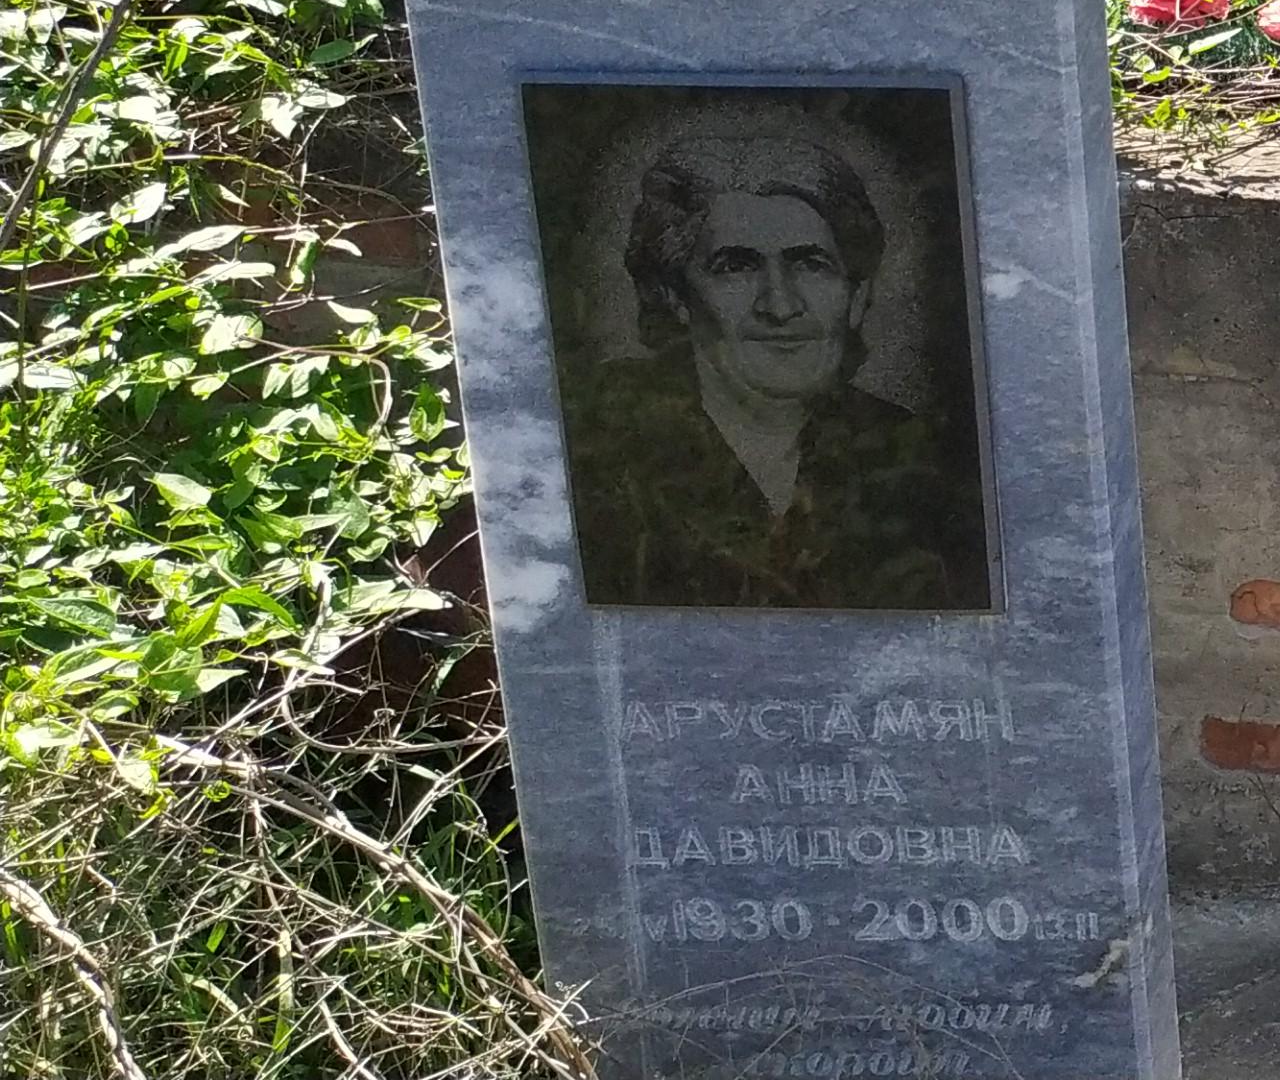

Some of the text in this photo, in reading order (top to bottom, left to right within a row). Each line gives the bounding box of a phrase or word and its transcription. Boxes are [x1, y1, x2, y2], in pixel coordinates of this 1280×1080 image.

[622, 697, 1016, 743] АРУСТАМЯН
[728, 763, 910, 806] АННА
[631, 824, 1031, 870] ДАВИДОВНА
[853, 895, 1031, 944] 2000
